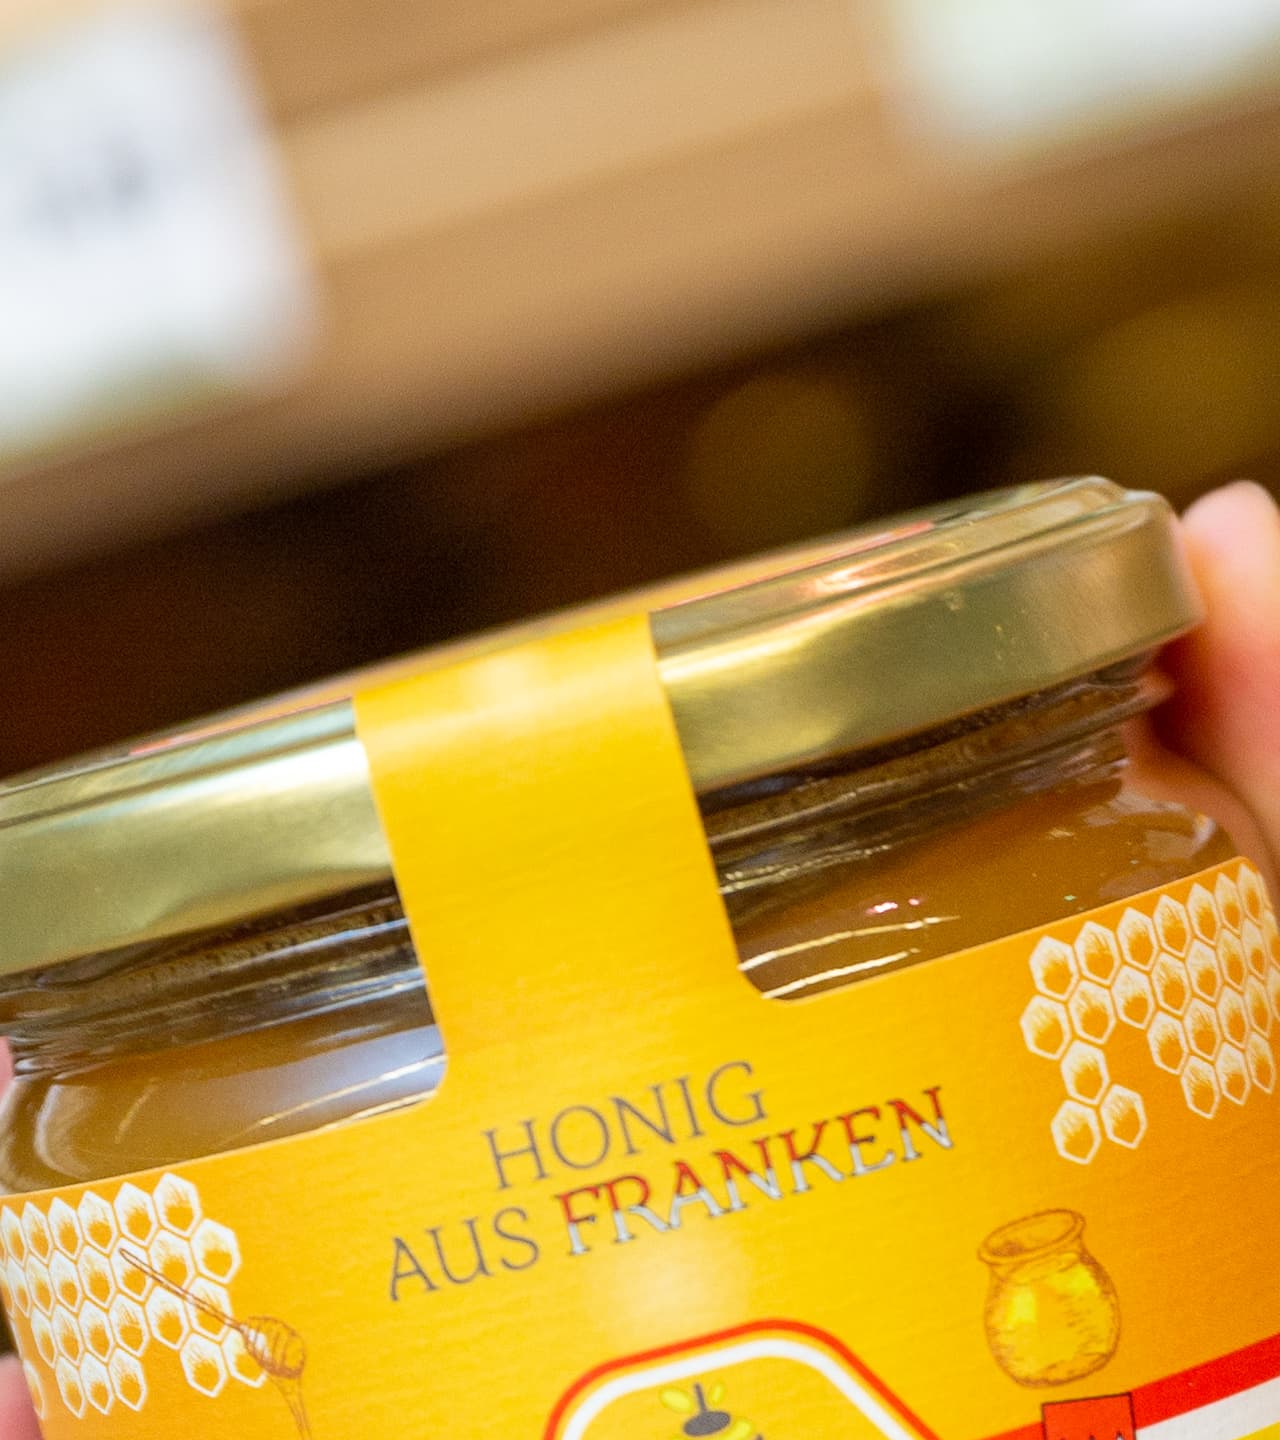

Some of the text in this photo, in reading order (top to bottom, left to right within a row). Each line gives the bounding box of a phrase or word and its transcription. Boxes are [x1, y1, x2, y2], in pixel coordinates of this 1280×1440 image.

[389, 1085, 955, 1302] AUS FRANKEN
[482, 1060, 769, 1190] HONIG
